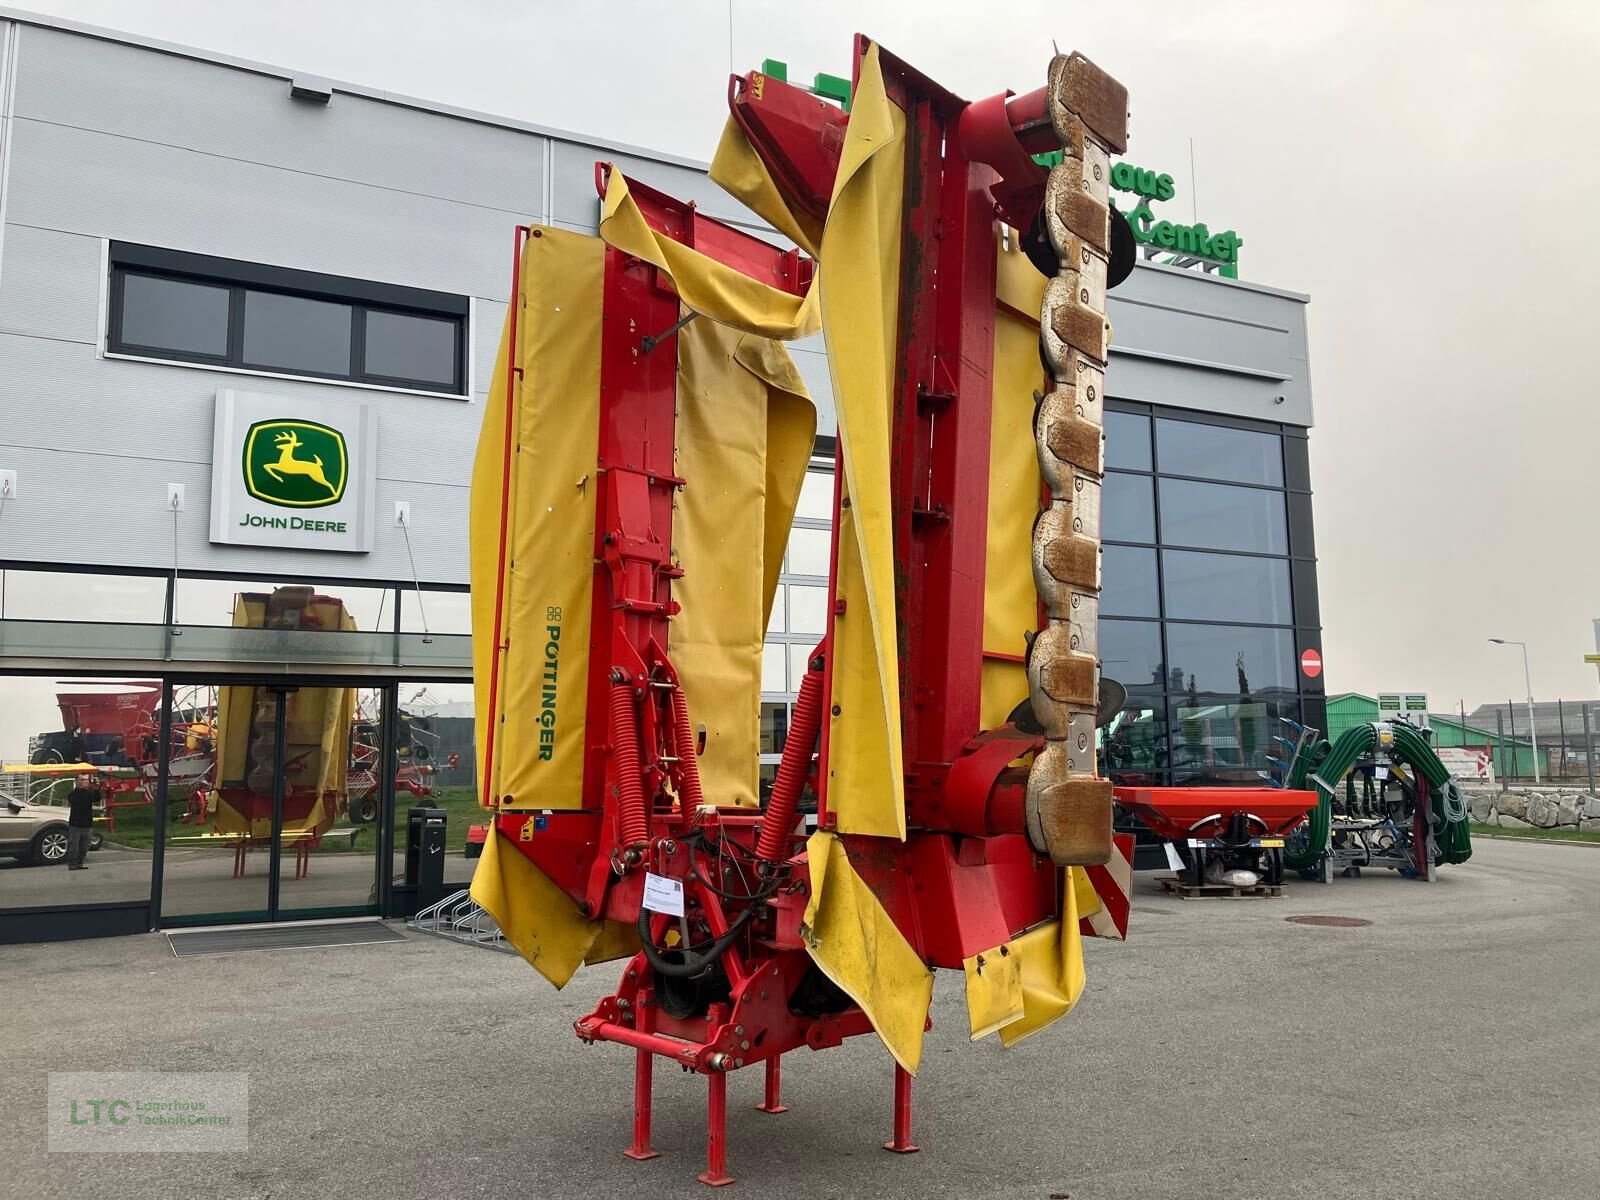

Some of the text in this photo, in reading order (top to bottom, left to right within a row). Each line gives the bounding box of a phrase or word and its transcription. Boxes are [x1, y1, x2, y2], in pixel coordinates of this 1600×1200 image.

[1110, 161, 1176, 202] aus
[1127, 205, 1243, 262] Center
[239, 513, 347, 533] JOHN DEERE
